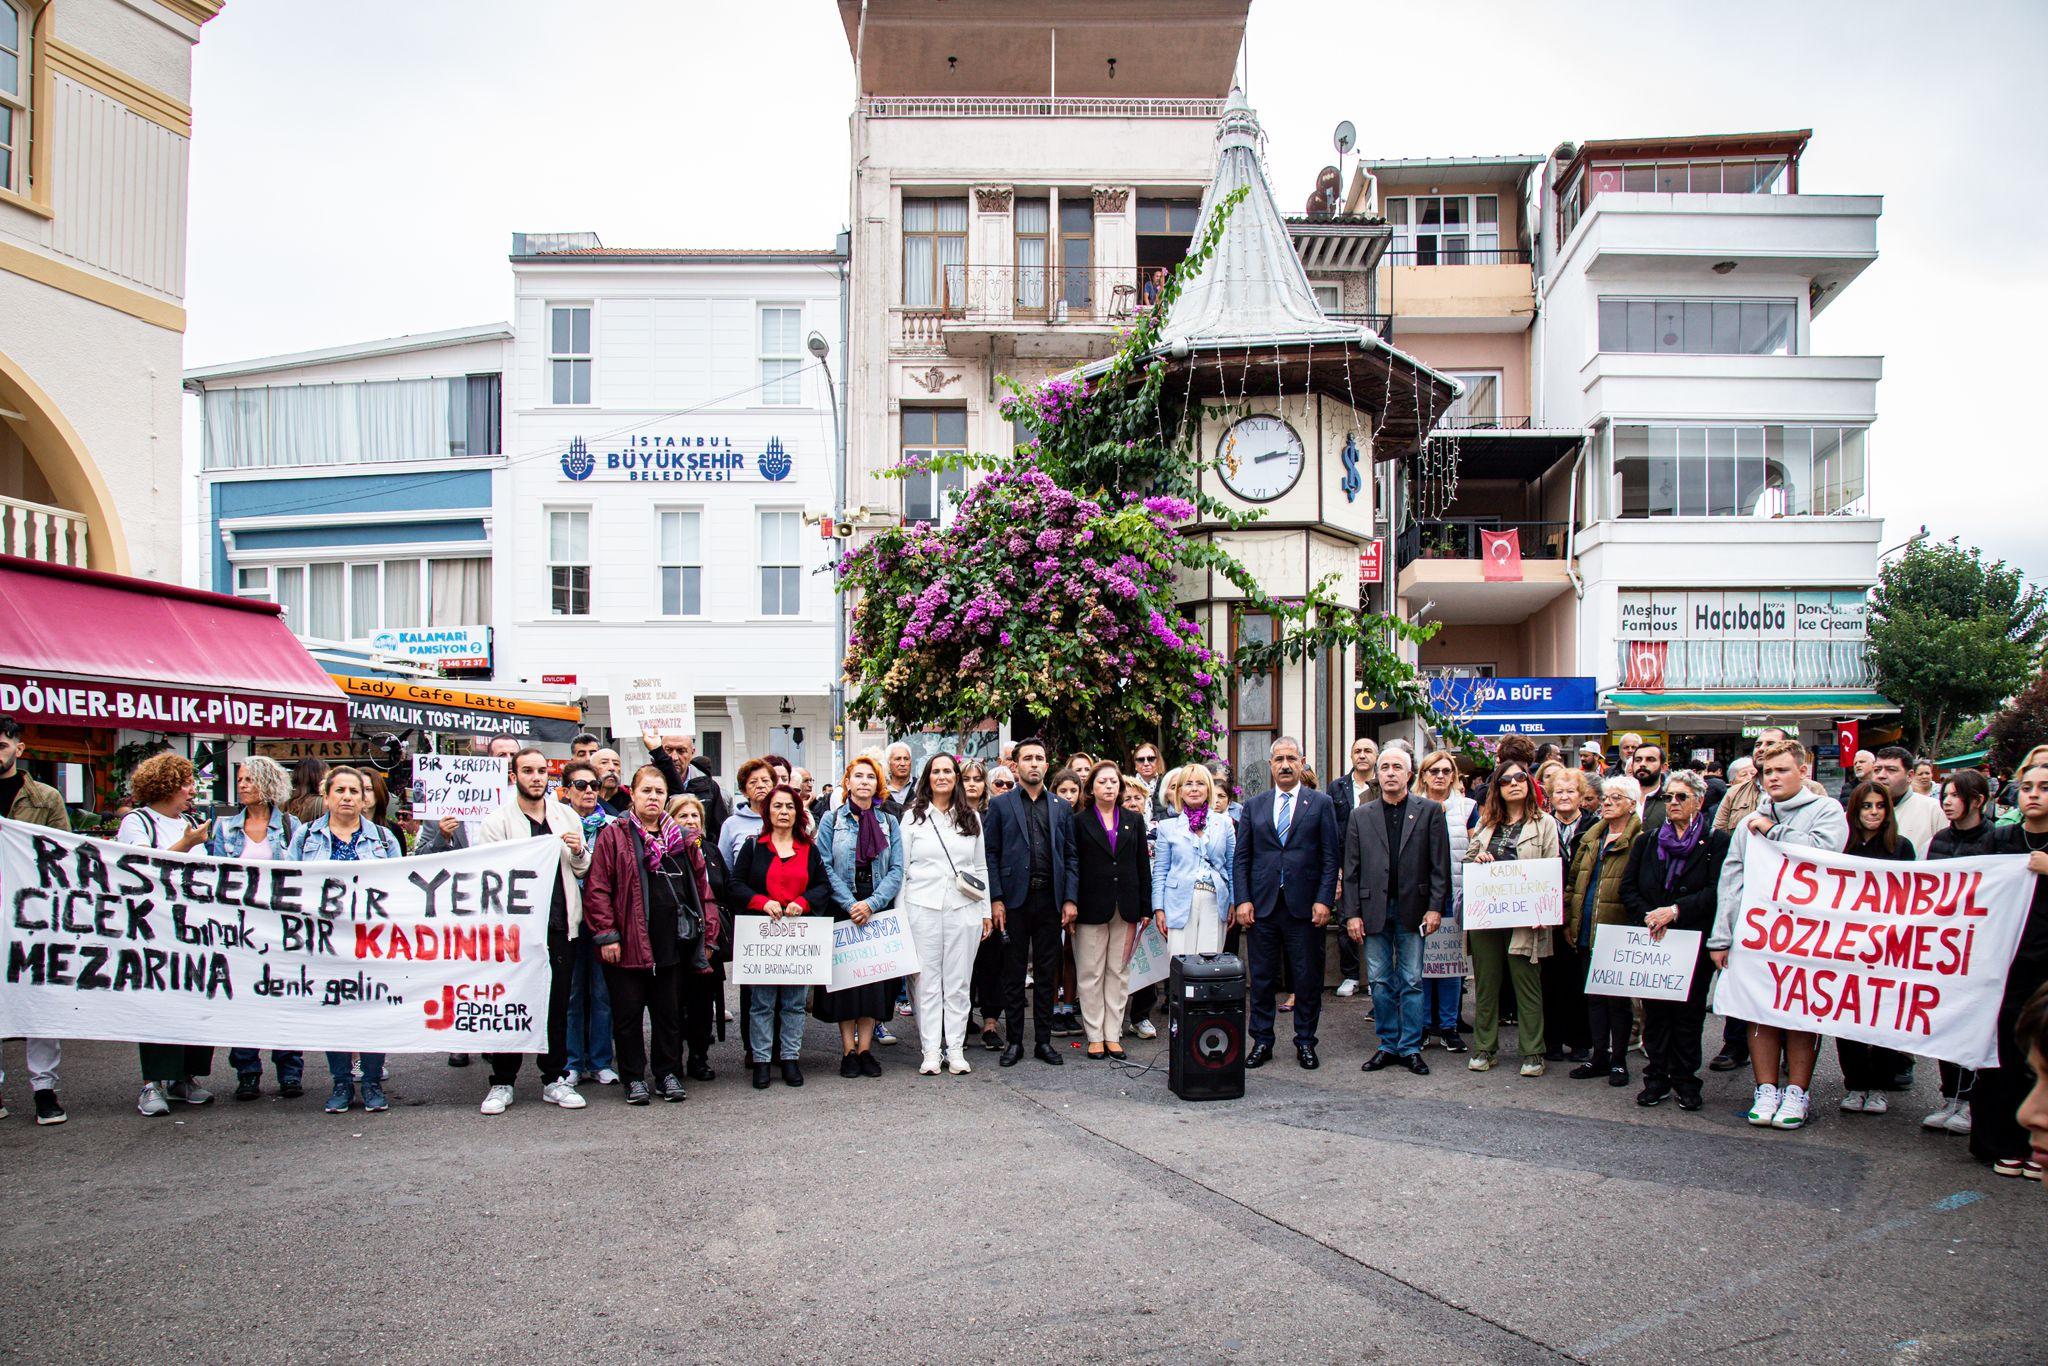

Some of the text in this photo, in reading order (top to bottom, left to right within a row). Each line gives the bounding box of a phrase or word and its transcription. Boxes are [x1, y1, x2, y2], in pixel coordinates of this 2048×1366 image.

[631, 435, 732, 447] İSTANBUL
[607, 449, 744, 470] BÜYÜKŞEHİR
[630, 469, 731, 481] BELEDİYESİ
[1622, 603, 1678, 619] Meşhur
[1695, 602, 1786, 631] Hacıbaba
[1621, 619, 1678, 631] Famous
[1798, 618, 1863, 630] Ice Cream
[409, 643, 467, 655] PANSİYON
[347, 677, 517, 711] Lady Cafe Latte
[1510, 684, 1553, 701] BÜFE
[1, 680, 338, 733] DÖNER-BALIK-PİDE-PİZZA
[425, 709, 530, 735] TOST-PİZZA-PİDE
[1498, 724, 1546, 732] ADA TEKEL
[452, 758, 501, 773] KEREDEN
[32, 834, 303, 913] RASTGELE
[408, 868, 538, 918] YERE
[1772, 853, 1989, 917] İSTANBUL
[1488, 901, 1529, 914] DUR DE
[13, 887, 156, 941] ÇİÇEK
[355, 922, 522, 963] KADININ
[1741, 907, 1976, 976] SÖZLEŞMESİ
[7, 941, 234, 1000] MEZARINA
[253, 963, 315, 997] denk
[743, 963, 762, 975] SON
[1591, 968, 1625, 986] KABUL
[456, 983, 506, 1001] CHP
[1767, 960, 1941, 1036] YAŞATIR
[456, 1002, 528, 1017] ADALAR
[455, 1016, 533, 1033] GENÇLİK
